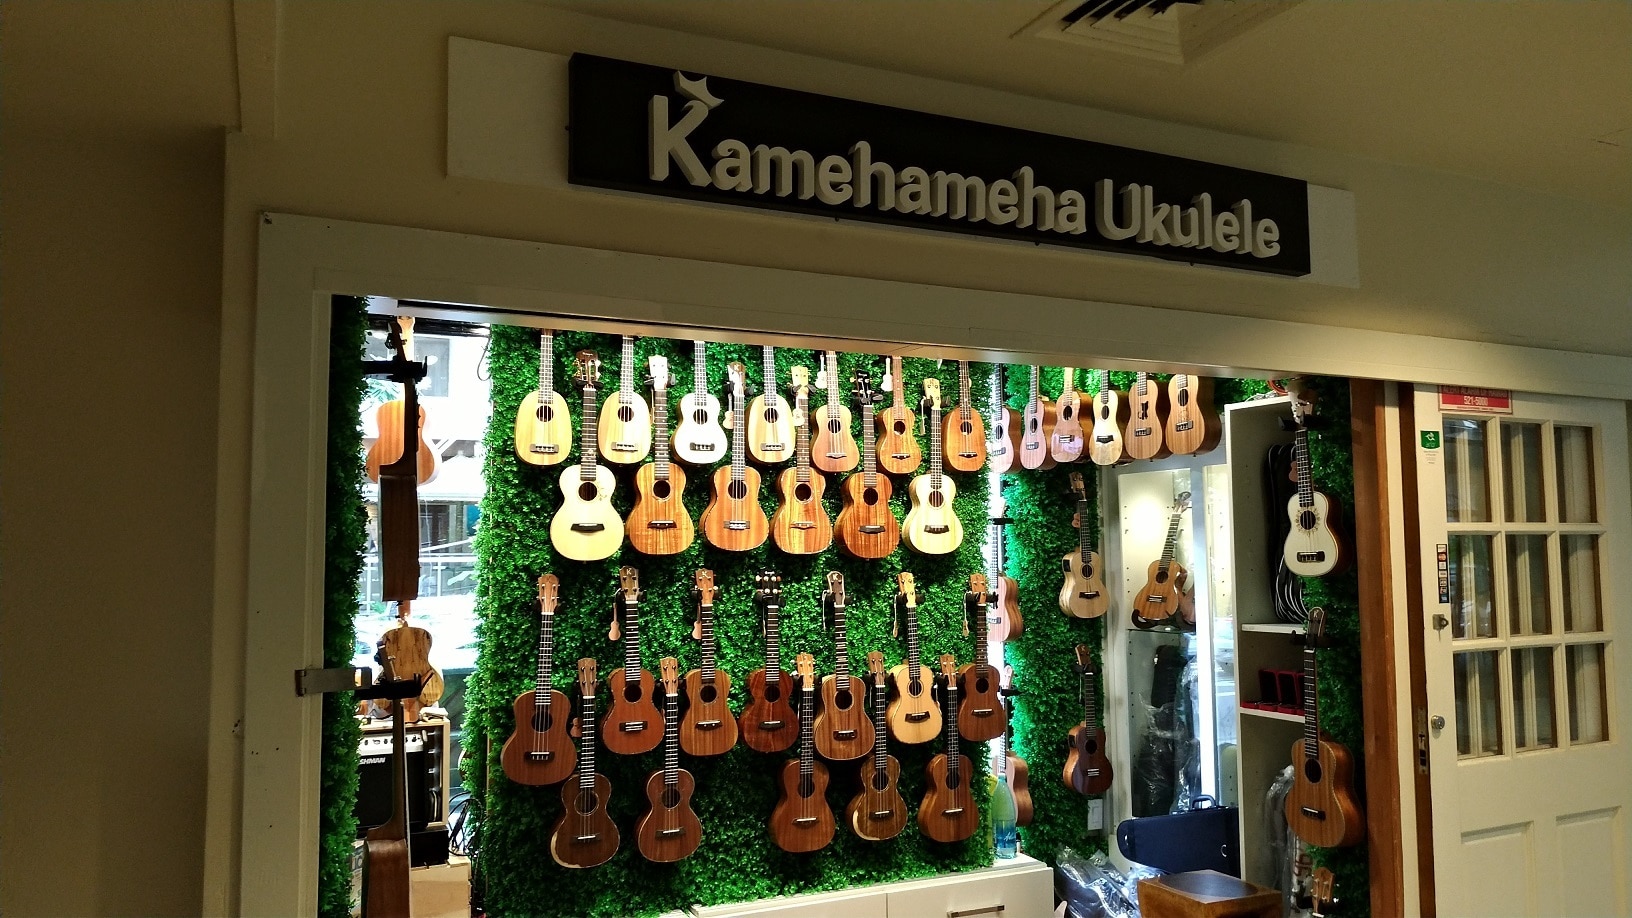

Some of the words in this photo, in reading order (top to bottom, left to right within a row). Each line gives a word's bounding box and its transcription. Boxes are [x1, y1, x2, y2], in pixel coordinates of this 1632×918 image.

[650, 94, 1086, 235] Kamehameha
[1095, 178, 1280, 258] Ukulele
[359, 757, 386, 765] SHMAN
